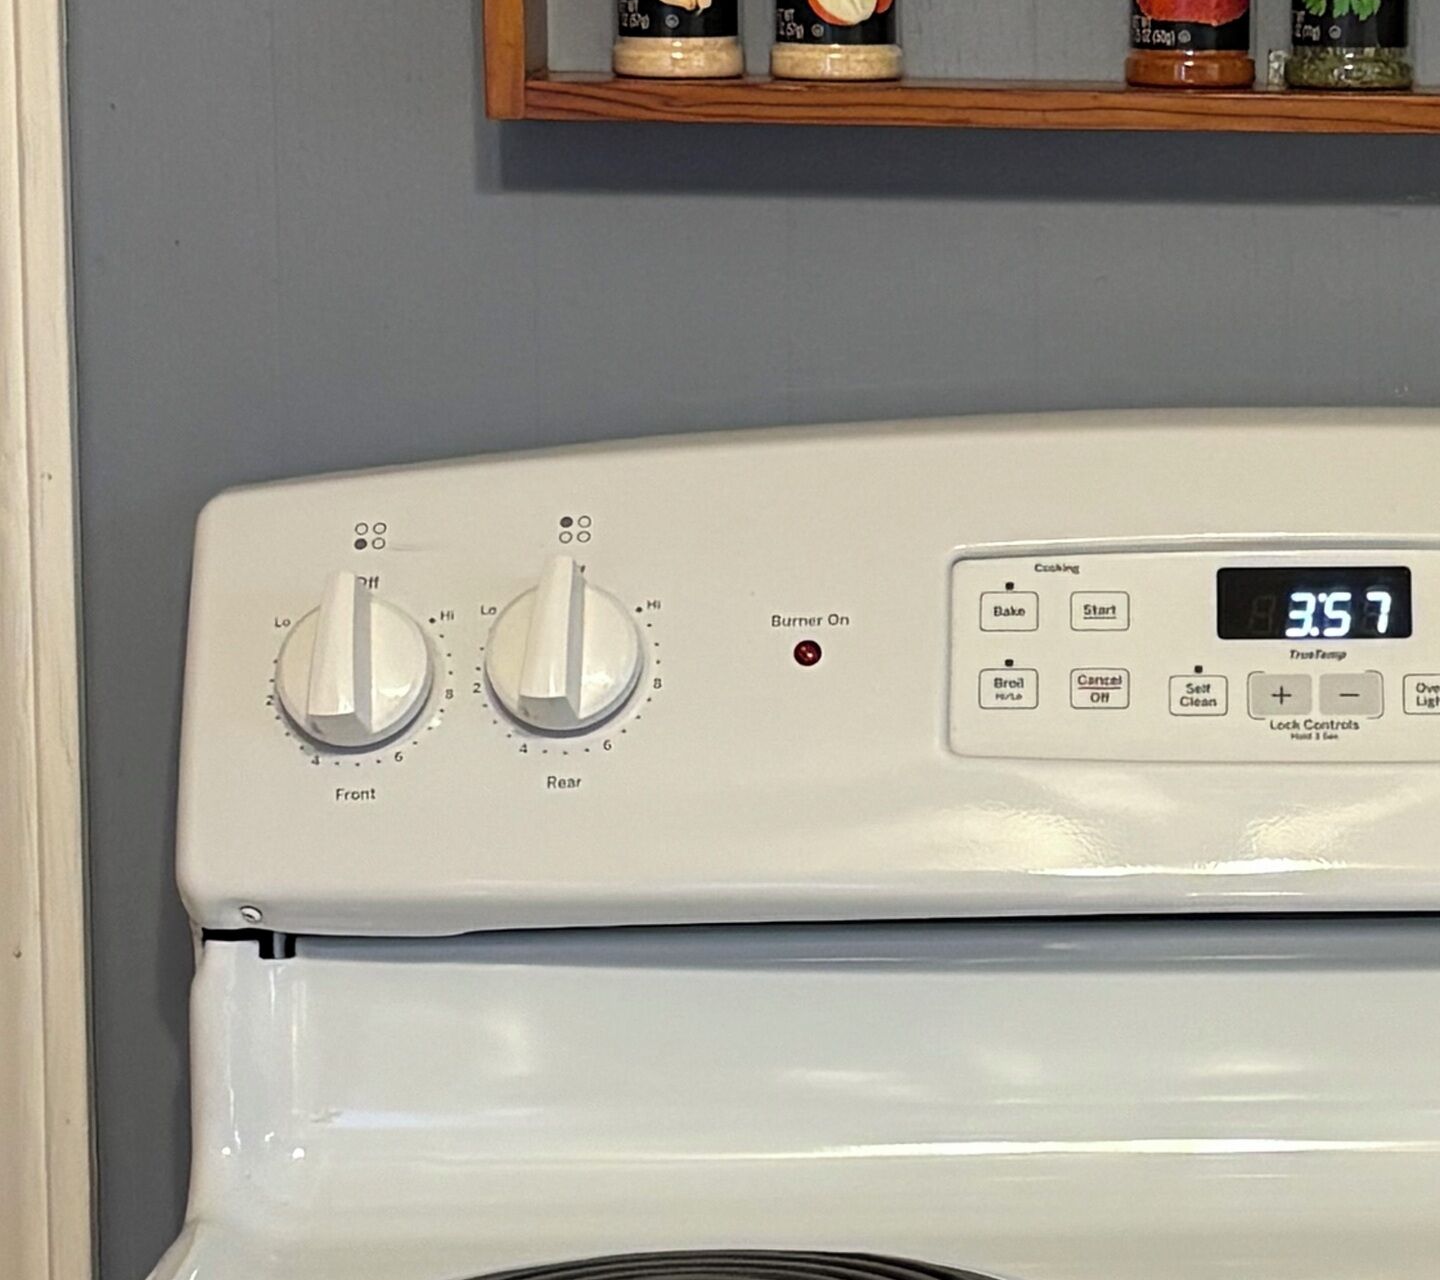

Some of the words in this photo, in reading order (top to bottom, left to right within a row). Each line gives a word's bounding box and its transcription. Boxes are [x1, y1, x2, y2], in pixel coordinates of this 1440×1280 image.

[480, 605, 497, 616] Lo
[647, 600, 662, 610] Hi
[993, 605, 1026, 617] Bake
[1083, 604, 1117, 617] Start
[440, 610, 455, 622] Hi
[771, 615, 823, 627] Burner
[828, 613, 850, 626] On
[1285, 592, 1392, 638] 3:57
[274, 617, 291, 628] Lo
[993, 677, 1025, 689] Broil
[1077, 674, 1122, 686] Cancel
[472, 683, 482, 693] 2
[1185, 682, 1211, 694] Self
[1090, 692, 1110, 703] Off
[1180, 696, 1217, 707] Clean
[1270, 720, 1300, 731] Lock
[1303, 719, 1360, 731] Controls
[519, 744, 528, 754] 4
[603, 740, 612, 751] 6
[394, 751, 404, 762] 6
[546, 776, 582, 789] Rear
[335, 788, 376, 801] Front
